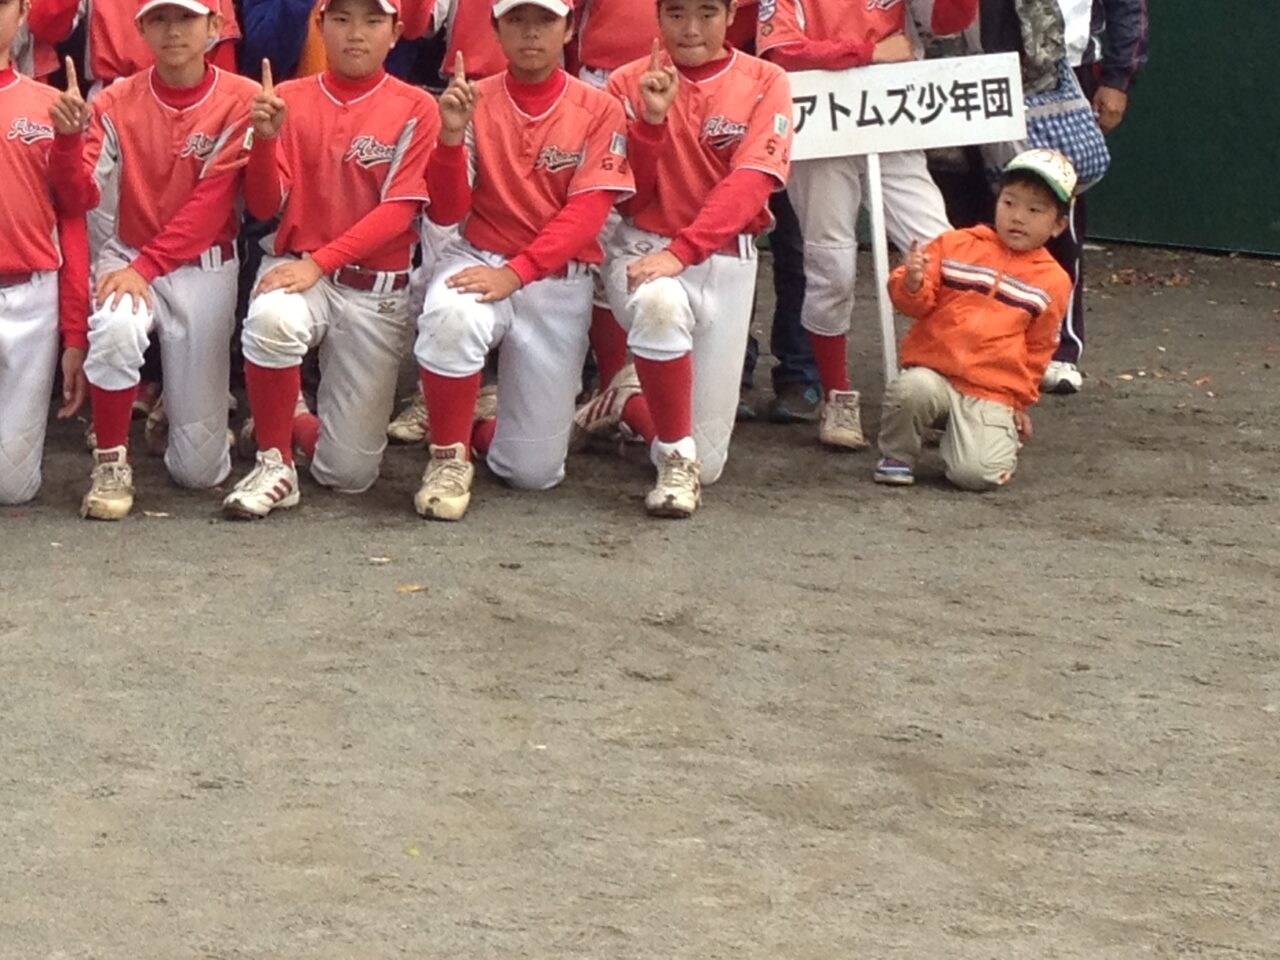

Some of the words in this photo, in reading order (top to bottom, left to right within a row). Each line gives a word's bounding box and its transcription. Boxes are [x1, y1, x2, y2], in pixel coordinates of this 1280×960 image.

[792, 77, 1014, 133] アトムズ少年団
